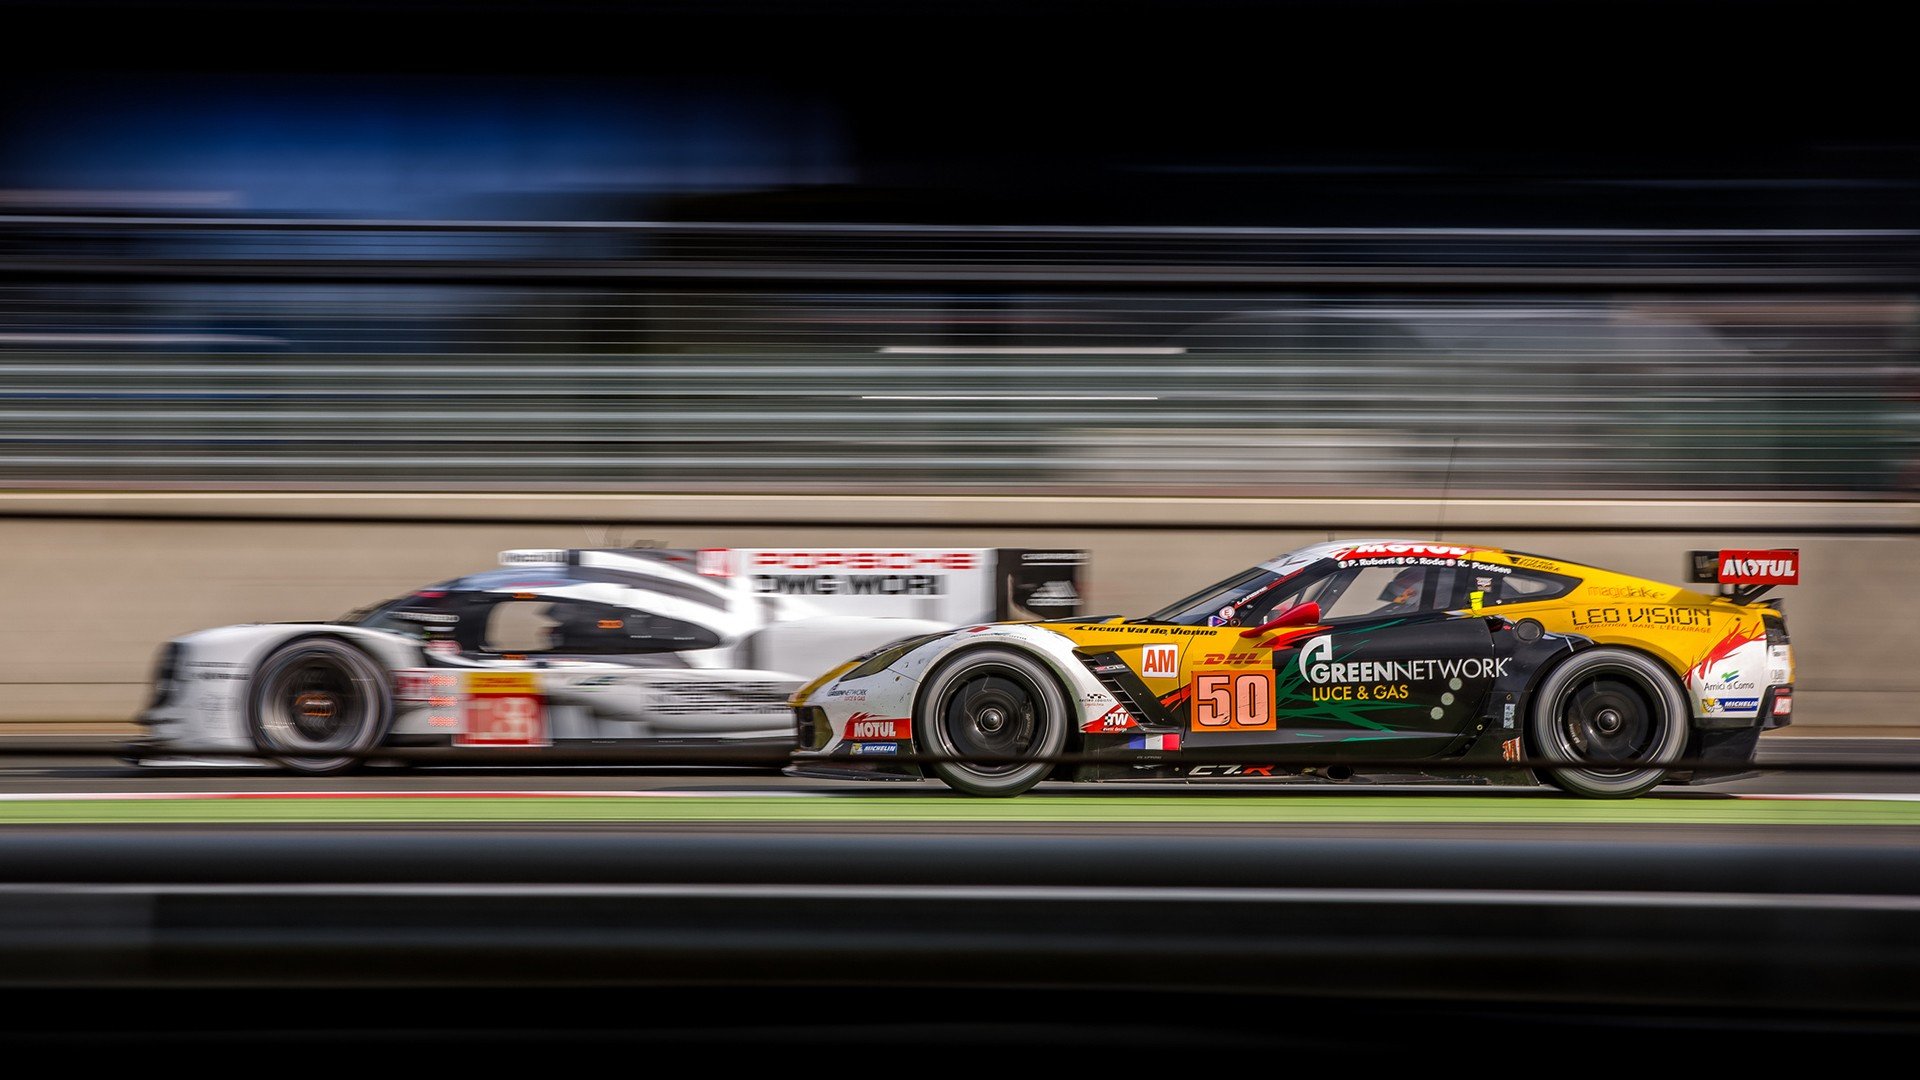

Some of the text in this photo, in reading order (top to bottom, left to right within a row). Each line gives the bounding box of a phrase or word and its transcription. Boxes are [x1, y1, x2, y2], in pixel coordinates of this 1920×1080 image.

[1420, 558, 1445, 566] Roda
[1722, 559, 1796, 577] MOTUL
[1627, 608, 1711, 626] VISION
[1144, 650, 1175, 673] AM
[1204, 653, 1262, 665] DHL
[1311, 684, 1409, 701] LUCE & GAS
[1733, 681, 1755, 690] Como
[1197, 674, 1271, 727] 50
[854, 722, 897, 737] MOTUL
[1188, 764, 1275, 776] C7.R
